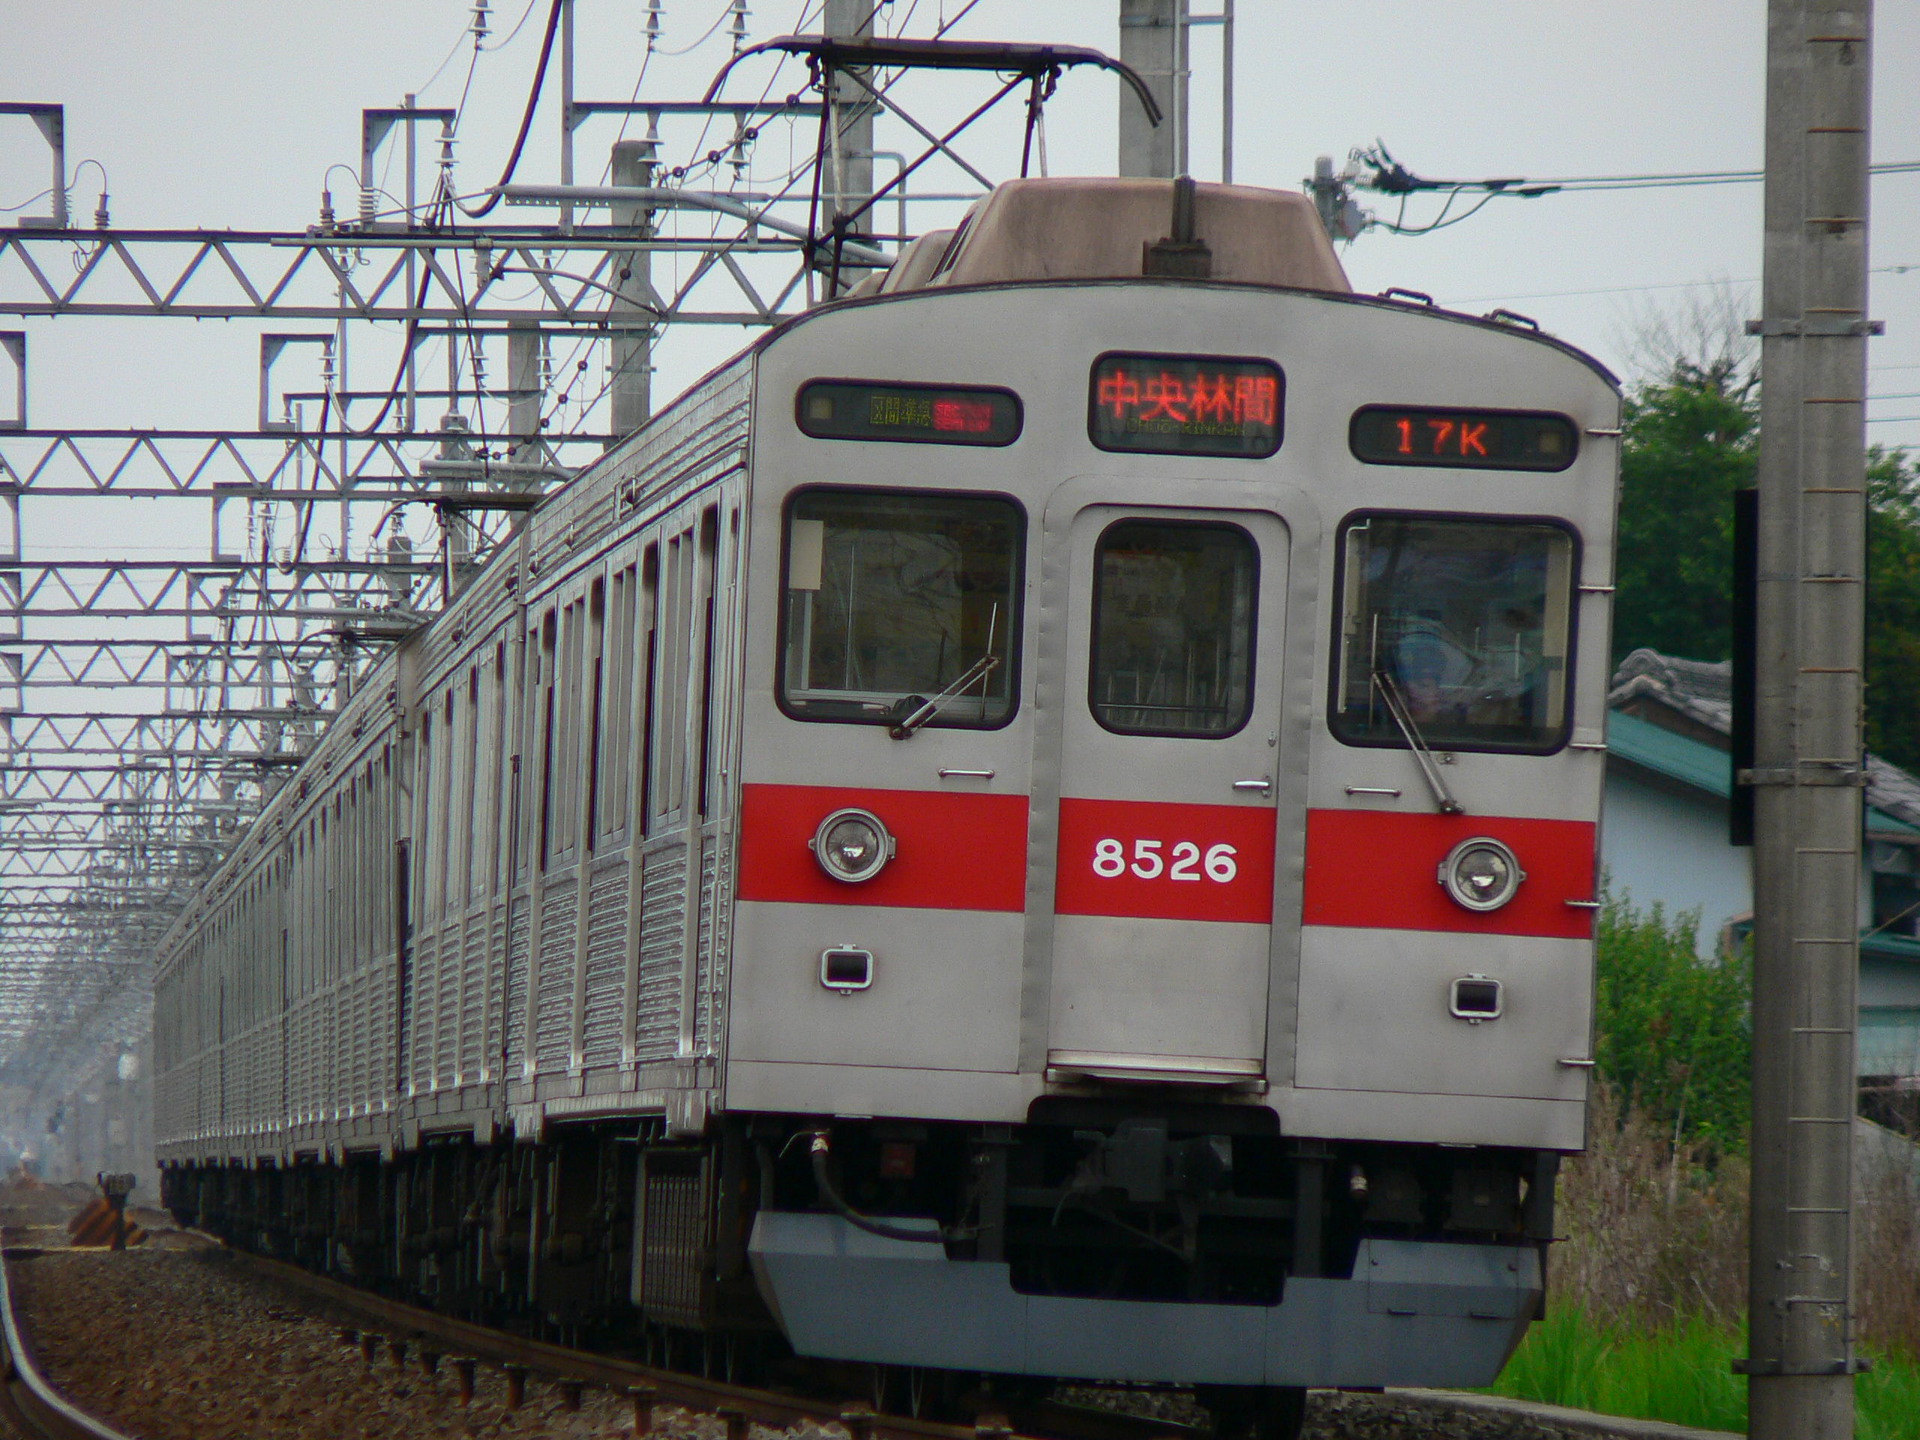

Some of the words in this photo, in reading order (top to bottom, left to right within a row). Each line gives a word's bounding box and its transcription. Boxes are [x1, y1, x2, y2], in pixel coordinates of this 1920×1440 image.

[870, 396, 931, 426] 区間準急
[1098, 370, 1277, 425] 中央林間
[1396, 417, 1488, 456] 17K
[1092, 838, 1238, 883] 8526
